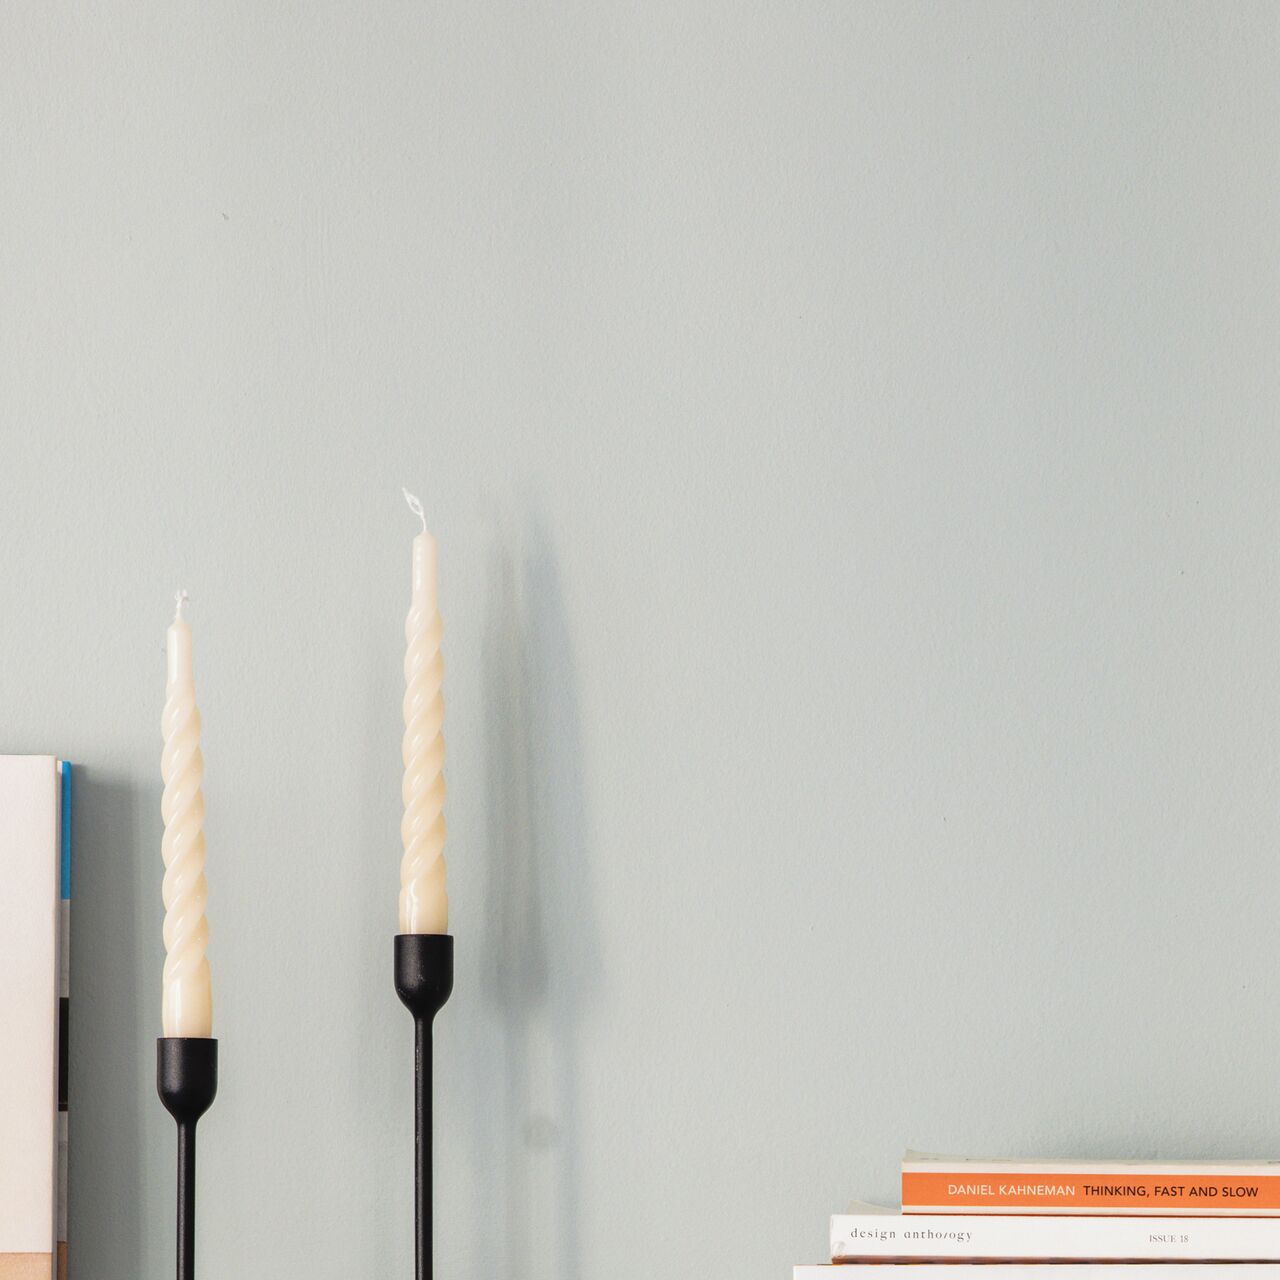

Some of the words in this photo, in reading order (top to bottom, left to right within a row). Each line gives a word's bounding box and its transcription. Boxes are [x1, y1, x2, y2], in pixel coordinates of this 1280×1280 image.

[947, 1184, 996, 1196] DANIEL
[998, 1184, 1076, 1197] KAHNEMAN
[1082, 1185, 1151, 1199] THINKING,
[1154, 1185, 1186, 1197] FAST
[1188, 1186, 1218, 1198] AND
[1221, 1186, 1259, 1198] SLOW
[850, 1227, 896, 1241] design
[1149, 1234, 1177, 1243] ISSUE
